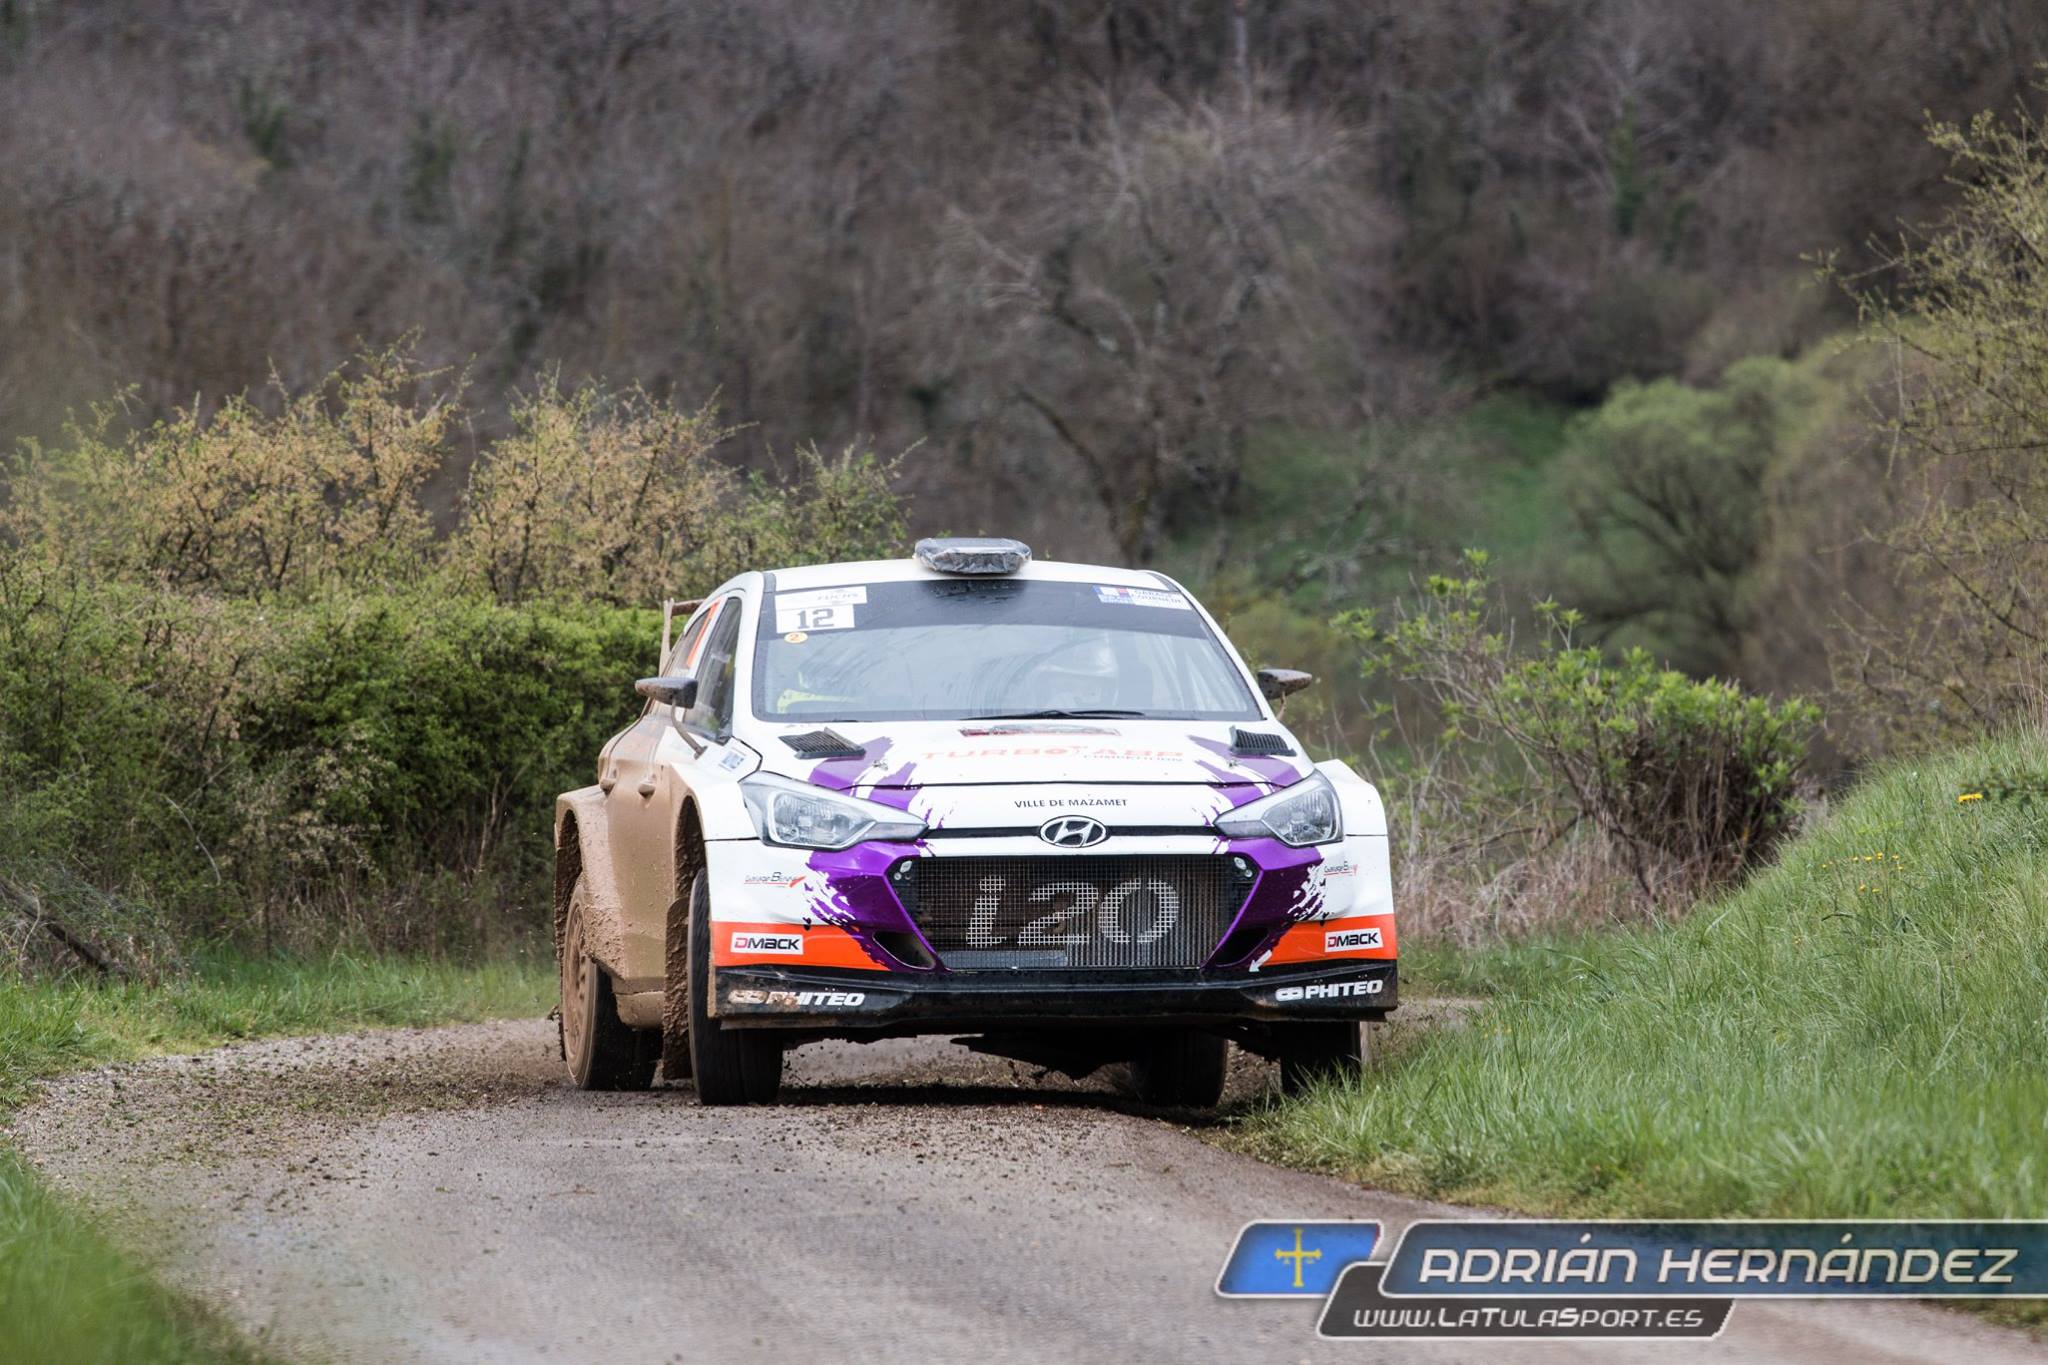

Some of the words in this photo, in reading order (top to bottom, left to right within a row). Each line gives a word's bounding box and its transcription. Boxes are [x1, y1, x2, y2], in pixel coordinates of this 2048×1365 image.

[797, 608, 834, 629] 12
[1014, 799, 1045, 808] VILLE
[1305, 979, 1384, 999] PHITEO
[765, 991, 866, 1006] PHITEO
